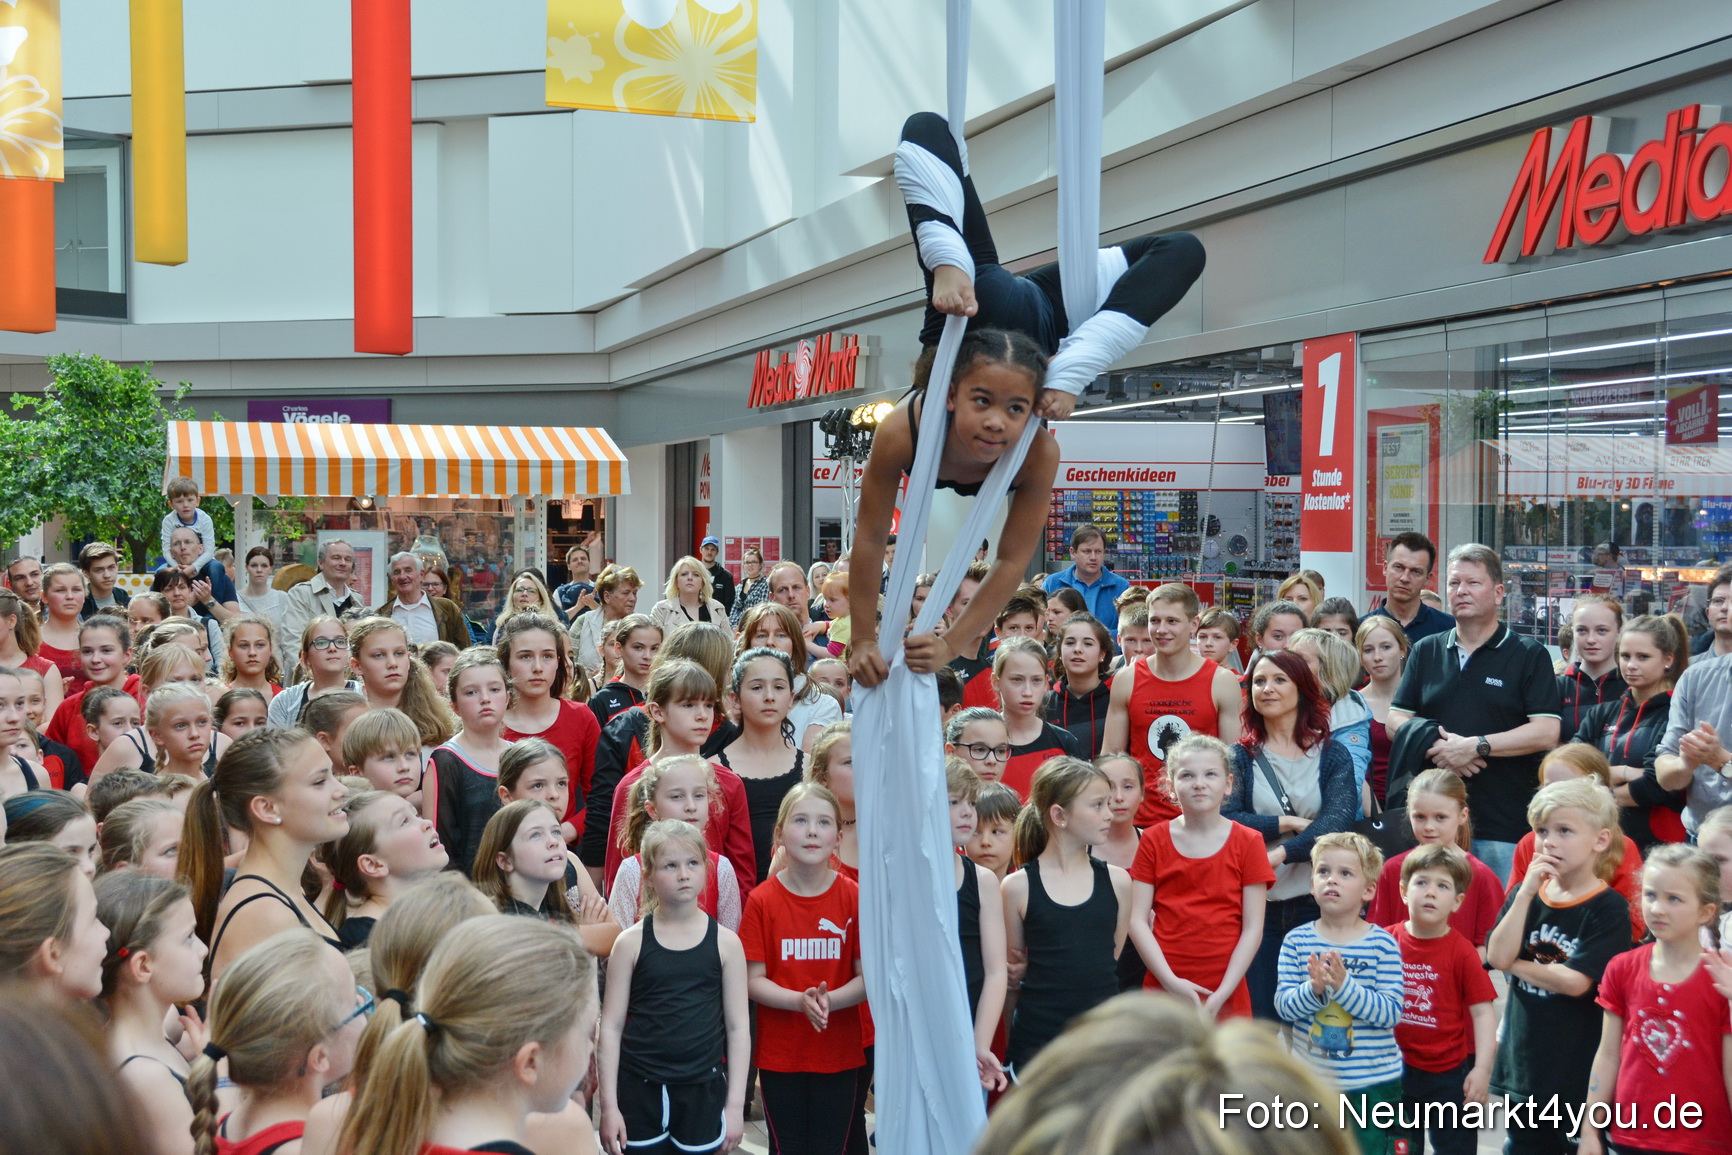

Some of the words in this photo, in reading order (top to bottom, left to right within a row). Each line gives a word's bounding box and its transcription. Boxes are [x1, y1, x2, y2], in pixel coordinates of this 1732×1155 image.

[1482, 103, 1732, 264] Media
[747, 349, 796, 408] Media
[806, 332, 859, 397] Markt
[1318, 352, 1341, 456] 1
[812, 464, 830, 480] ce
[1066, 467, 1176, 482] Geschenkideen
[1264, 475, 1291, 487] abel
[1311, 467, 1343, 487] Stunde
[1384, 465, 1420, 479] SERVICE
[1389, 481, 1415, 499] KÖNIG
[1577, 476, 1623, 492] Blu-ray
[1625, 477, 1640, 490] 3D
[781, 937, 841, 960] PUMA
